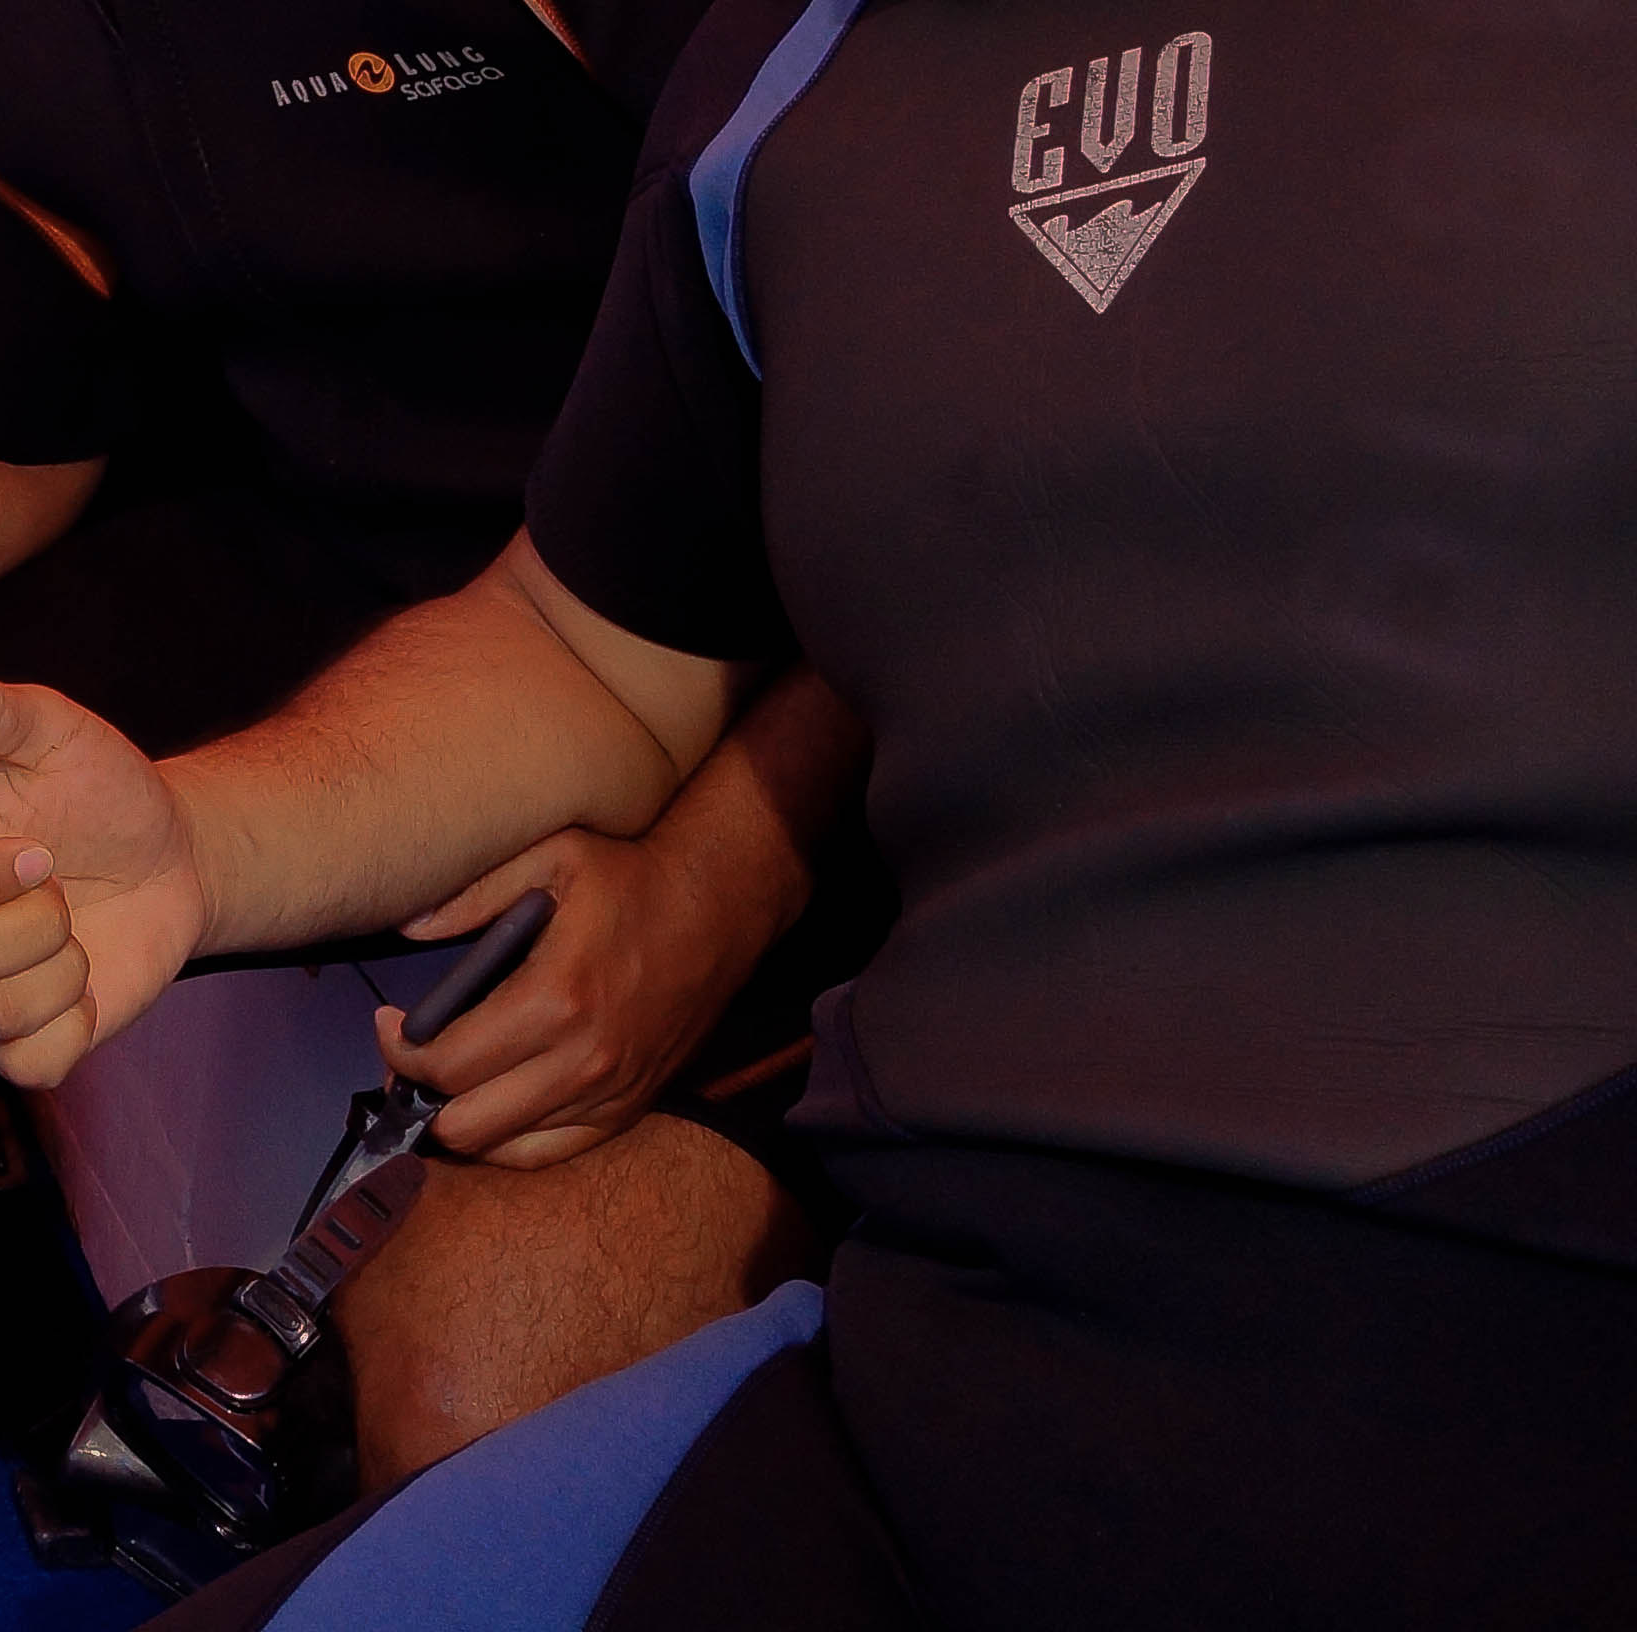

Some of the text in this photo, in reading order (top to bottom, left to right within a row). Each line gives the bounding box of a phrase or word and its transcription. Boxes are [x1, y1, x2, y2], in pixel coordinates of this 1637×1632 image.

[270, 45, 486, 107] AQUA LUNG
[1011, 30, 1213, 194] EVO
